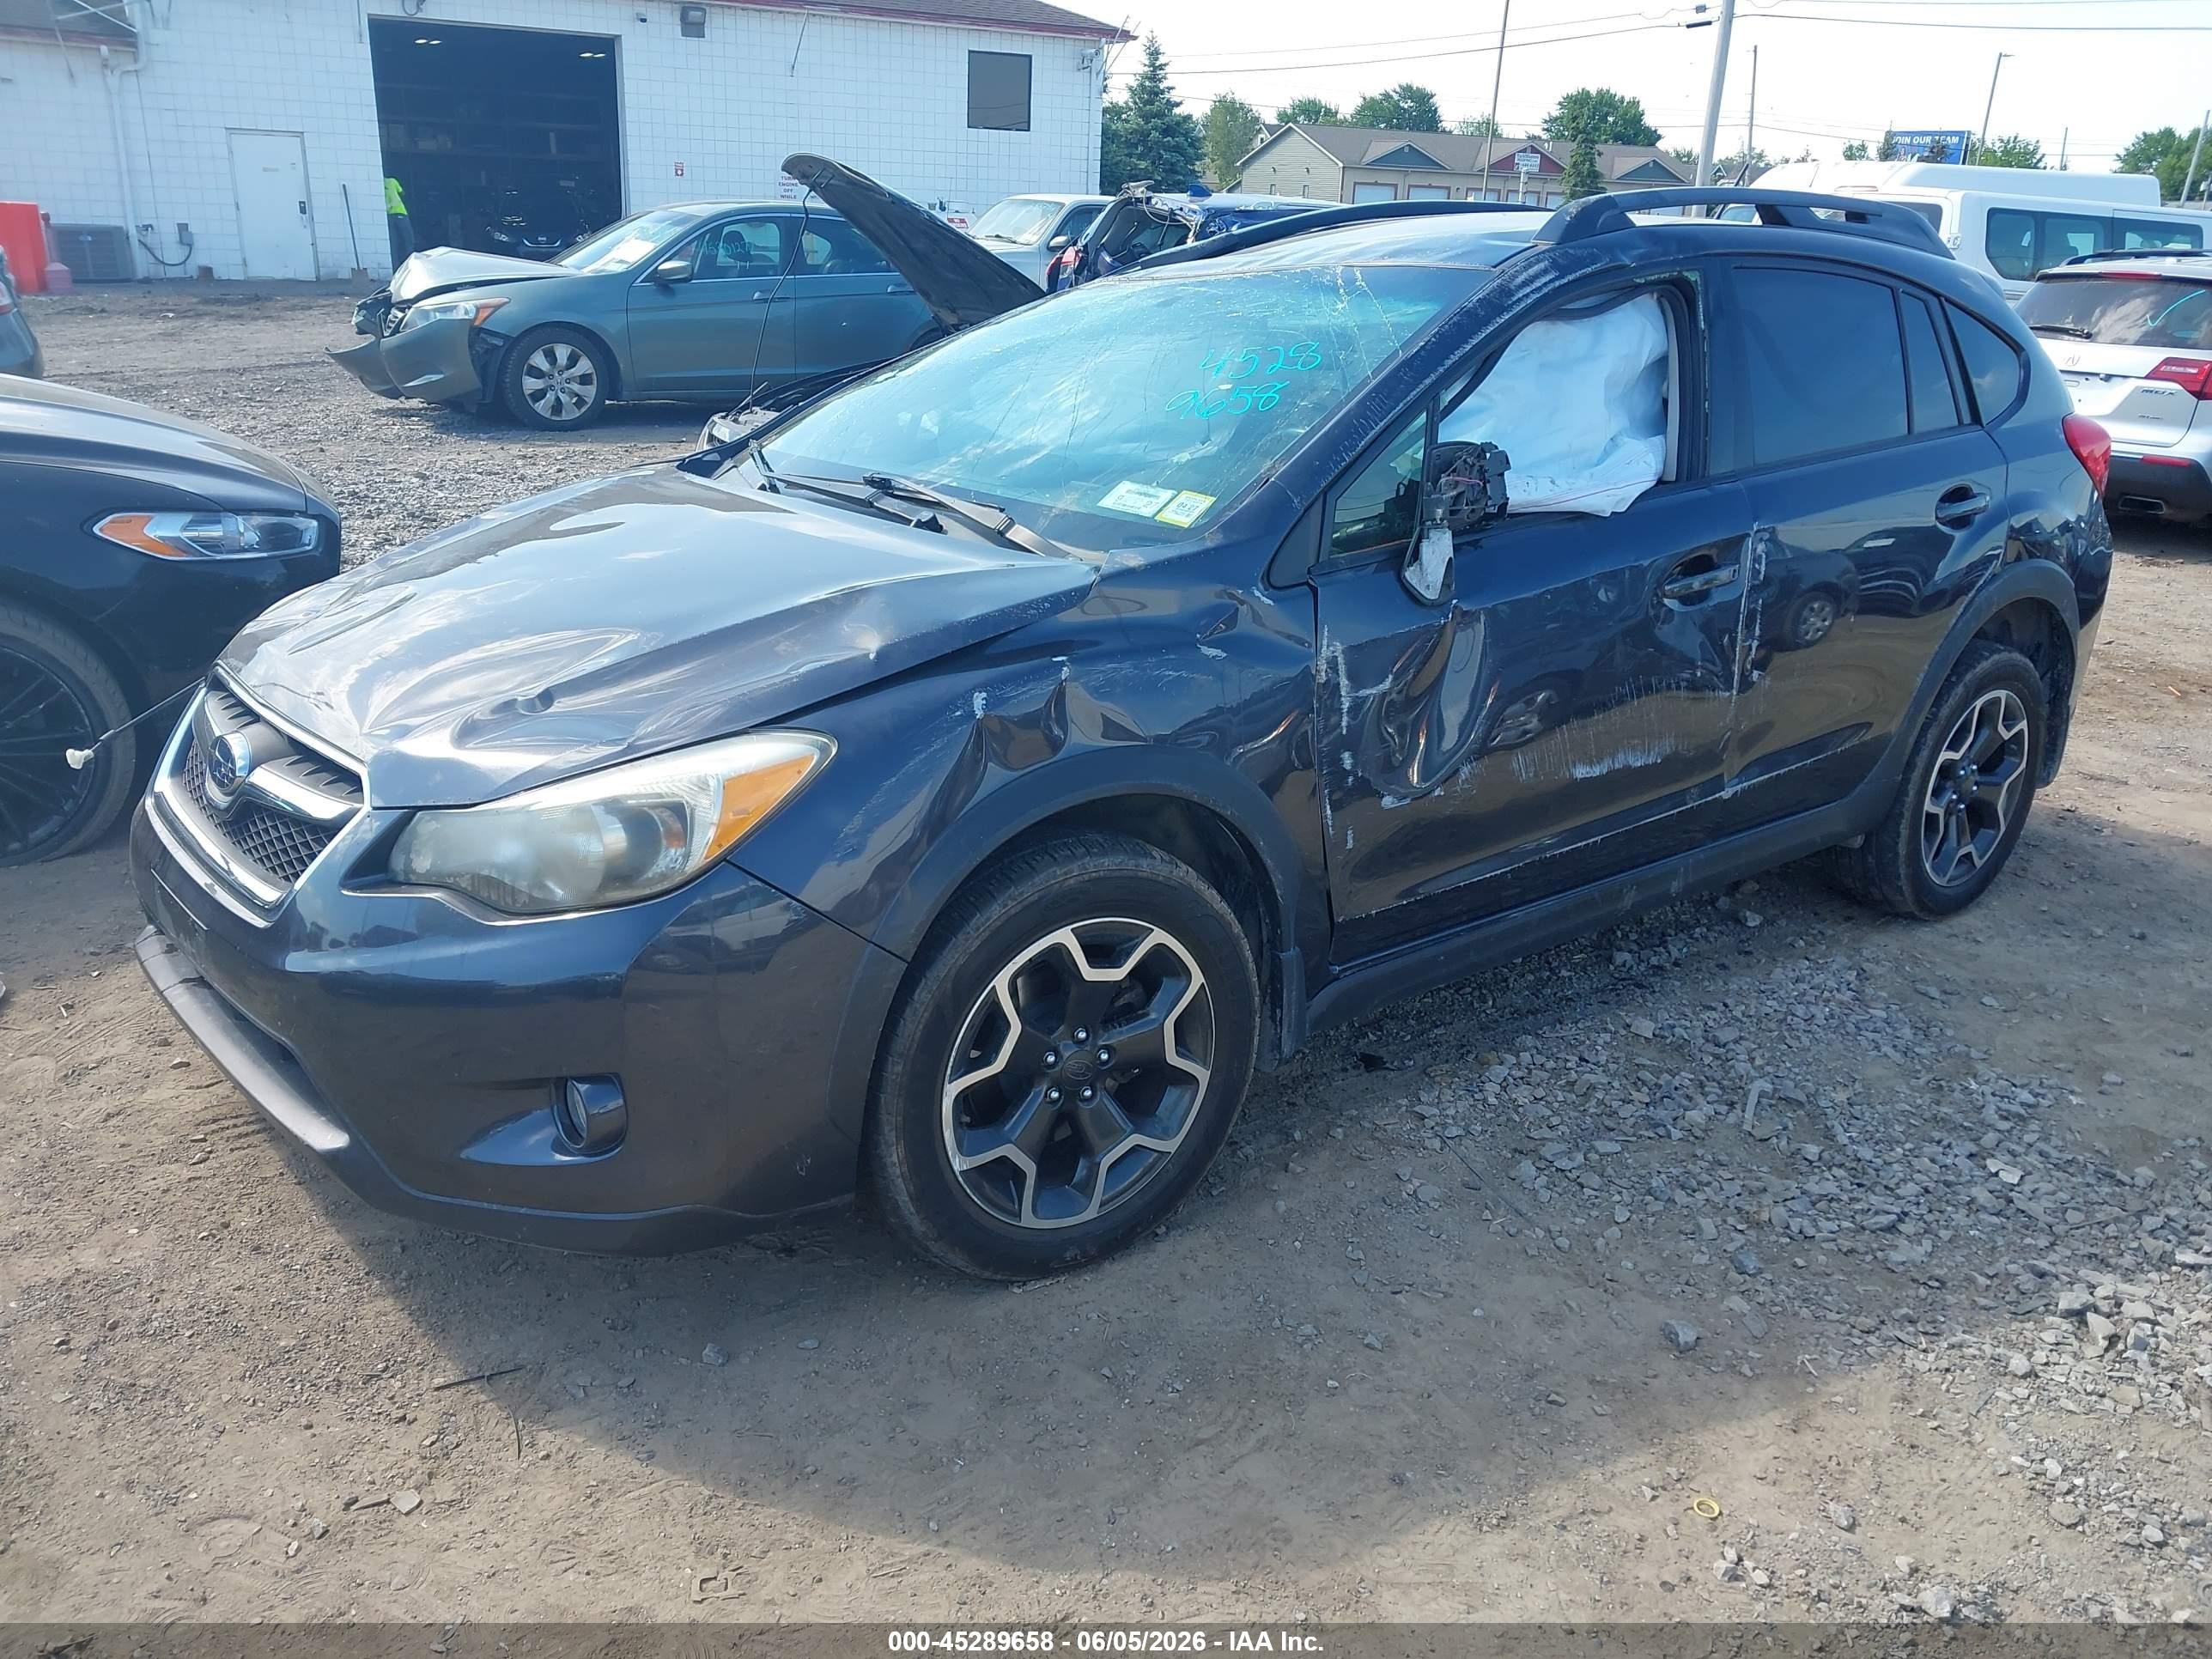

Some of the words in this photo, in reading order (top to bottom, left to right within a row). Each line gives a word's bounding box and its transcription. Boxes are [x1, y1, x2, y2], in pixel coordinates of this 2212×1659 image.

[1892, 136, 1911, 144] JOIN
[1912, 136, 1932, 145] OUR
[1199, 341, 1323, 379] 4528
[1165, 380, 1290, 420] 9658
